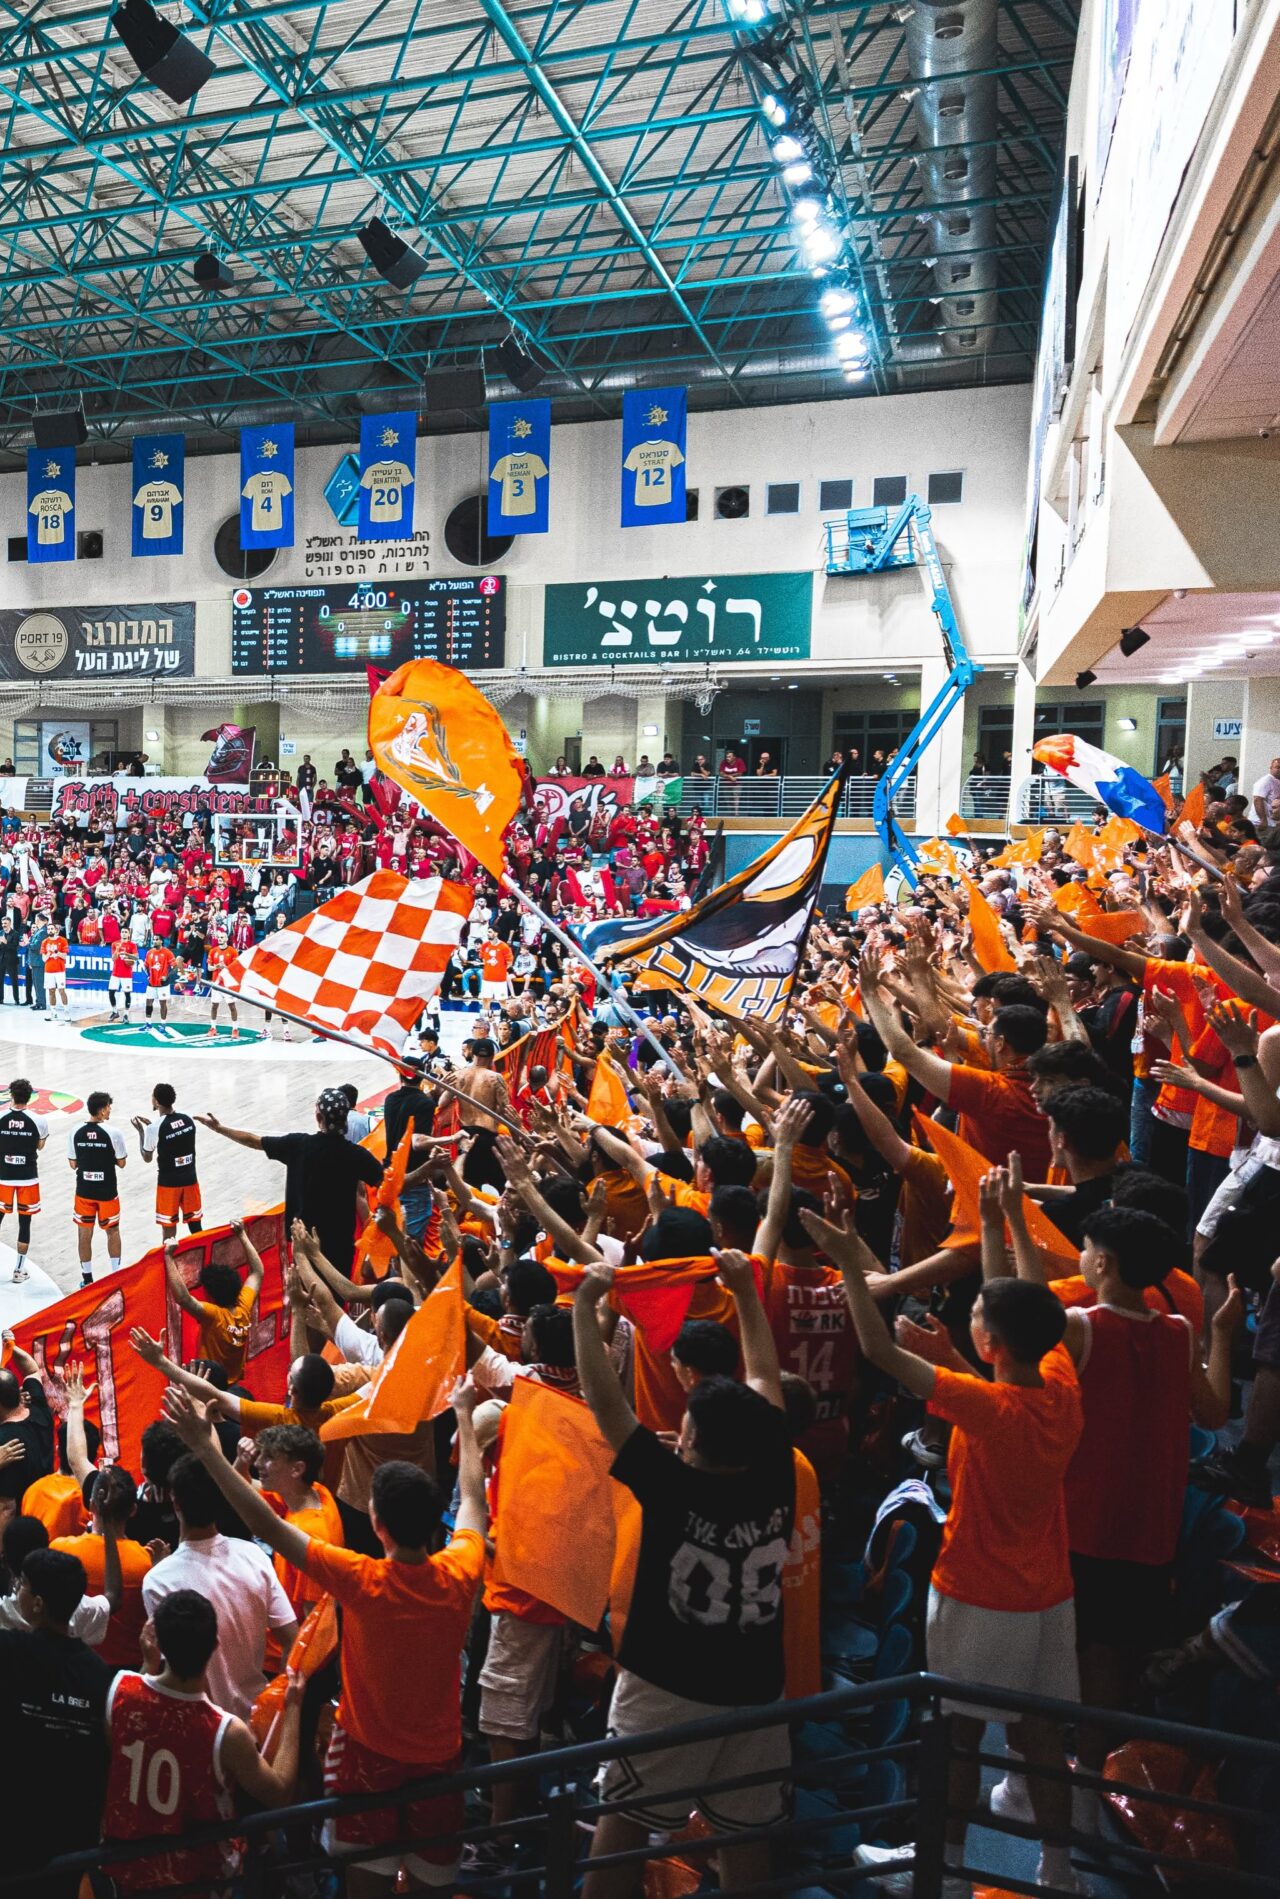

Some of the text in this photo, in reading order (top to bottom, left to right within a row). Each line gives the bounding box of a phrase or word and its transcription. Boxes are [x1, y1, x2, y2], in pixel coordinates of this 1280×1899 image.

[509, 462, 529, 471] נאמן
[643, 459, 665, 467] STRAT
[395, 468, 402, 476] בן
[641, 467, 665, 487] 12
[373, 477, 384, 485] BEN
[147, 490, 170, 498] אברהם
[512, 479, 524, 497] 3
[374, 488, 400, 506] 20
[40, 504, 62, 512] ROSCA
[261, 496, 273, 513] 4
[150, 504, 164, 522] 9
[41, 514, 61, 529] 18
[305, 551, 334, 563] ונופש
[447, 581, 475, 590] הפועל
[347, 591, 388, 610] 4:00
[320, 604, 330, 618] 0
[401, 601, 411, 615] 0
[337, 621, 345, 632] 0
[384, 620, 392, 630] 0
[20, 632, 63, 644] PORT 19
[81, 619, 173, 646] המבורגר
[75, 647, 180, 671] של ליגת העל
[553, 649, 680, 661] BISTRO & COCKTAILS BAR
[1215, 722, 1222, 735] 4
[53, 782, 119, 818] Faith
[8, 1119, 25, 1129] קפלן
[15, 1156, 25, 1164] RK
[94, 1172, 104, 1180] RK
[821, 1313, 844, 1329] RK
[789, 1340, 835, 1391] 14
[51, 1692, 91, 1709] LA BREA
[121, 1738, 181, 1815] 10
